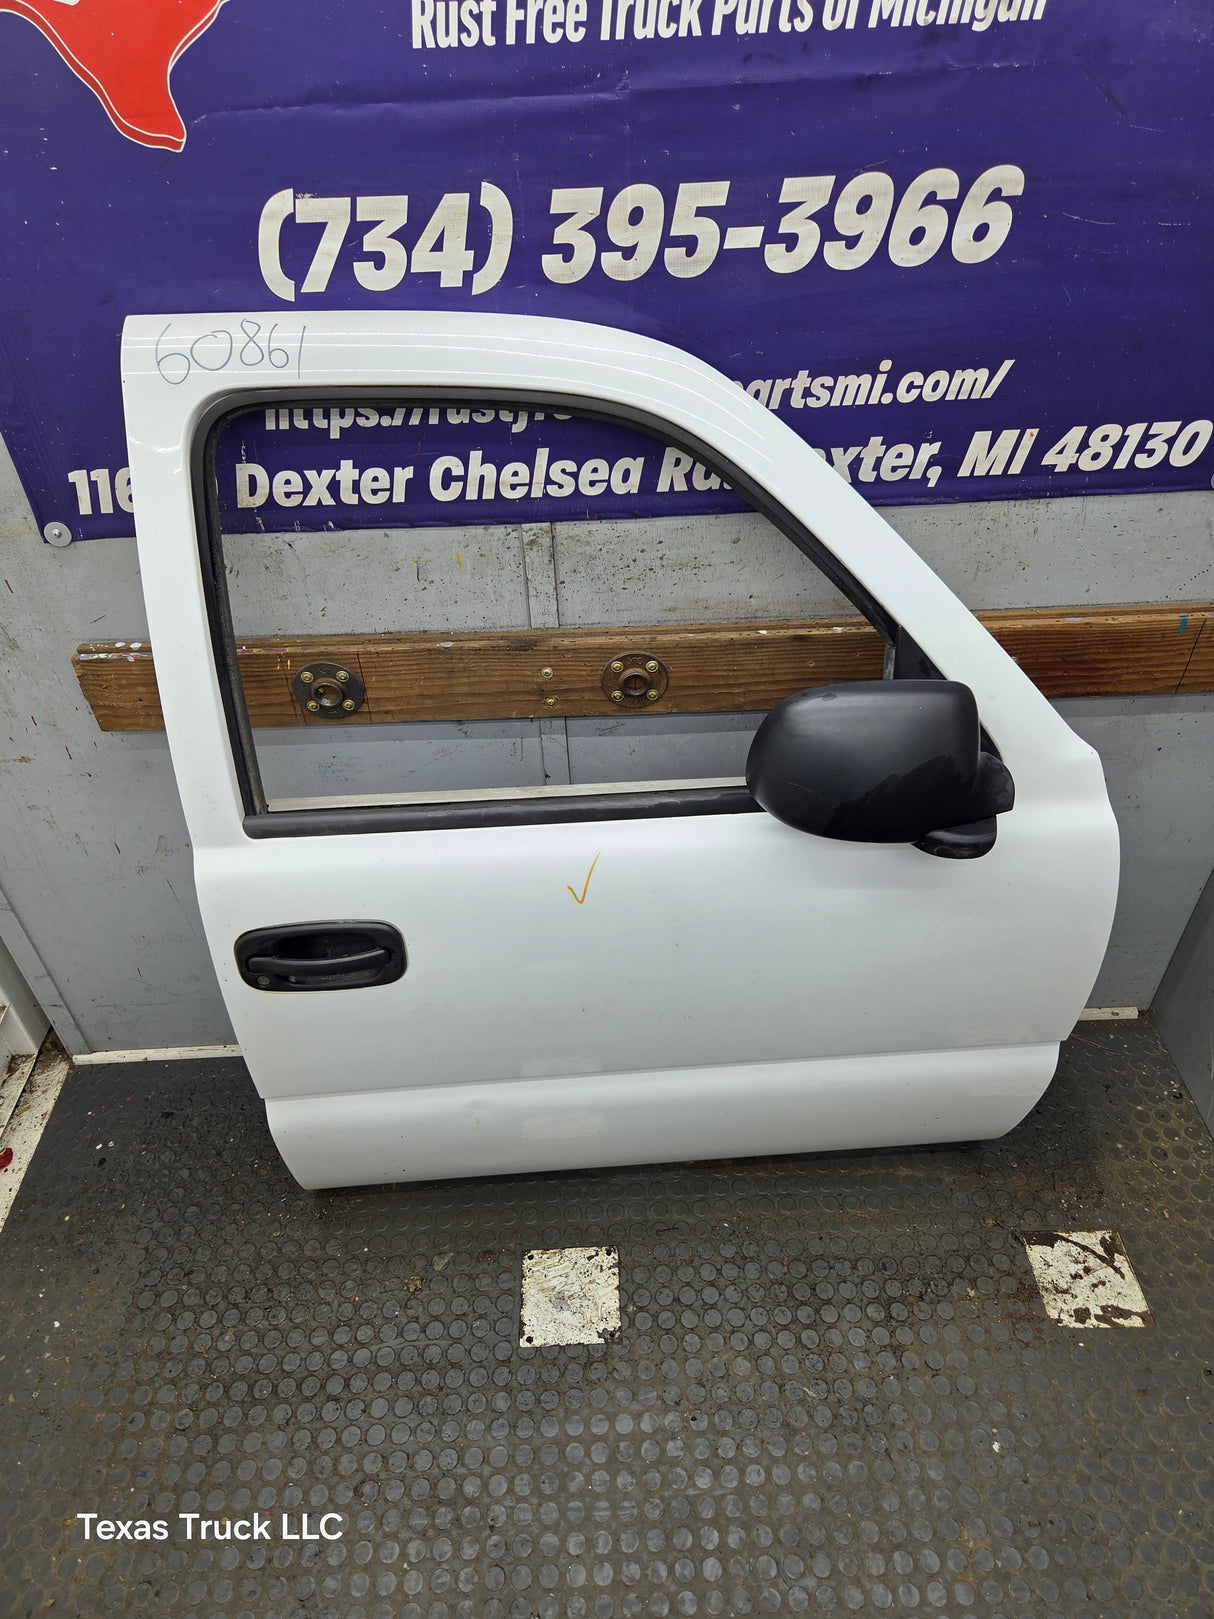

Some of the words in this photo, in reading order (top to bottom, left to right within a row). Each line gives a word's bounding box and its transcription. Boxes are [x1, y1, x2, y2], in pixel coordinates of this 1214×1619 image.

[411, 0, 497, 49] Rust
[505, 0, 588, 45] Free
[600, 0, 702, 41] Truck
[711, 0, 814, 36] Parts
[257, 181, 513, 302] (734)
[541, 164, 1025, 284] 395-3966
[155, 318, 306, 385] 60861
[732, 359, 1016, 410] artsmi.com/
[235, 459, 414, 509] Dexter
[428, 447, 645, 502] Chelsea
[812, 435, 942, 489] xter,
[956, 427, 1039, 478] MI
[1040, 419, 1214, 473] 48130
